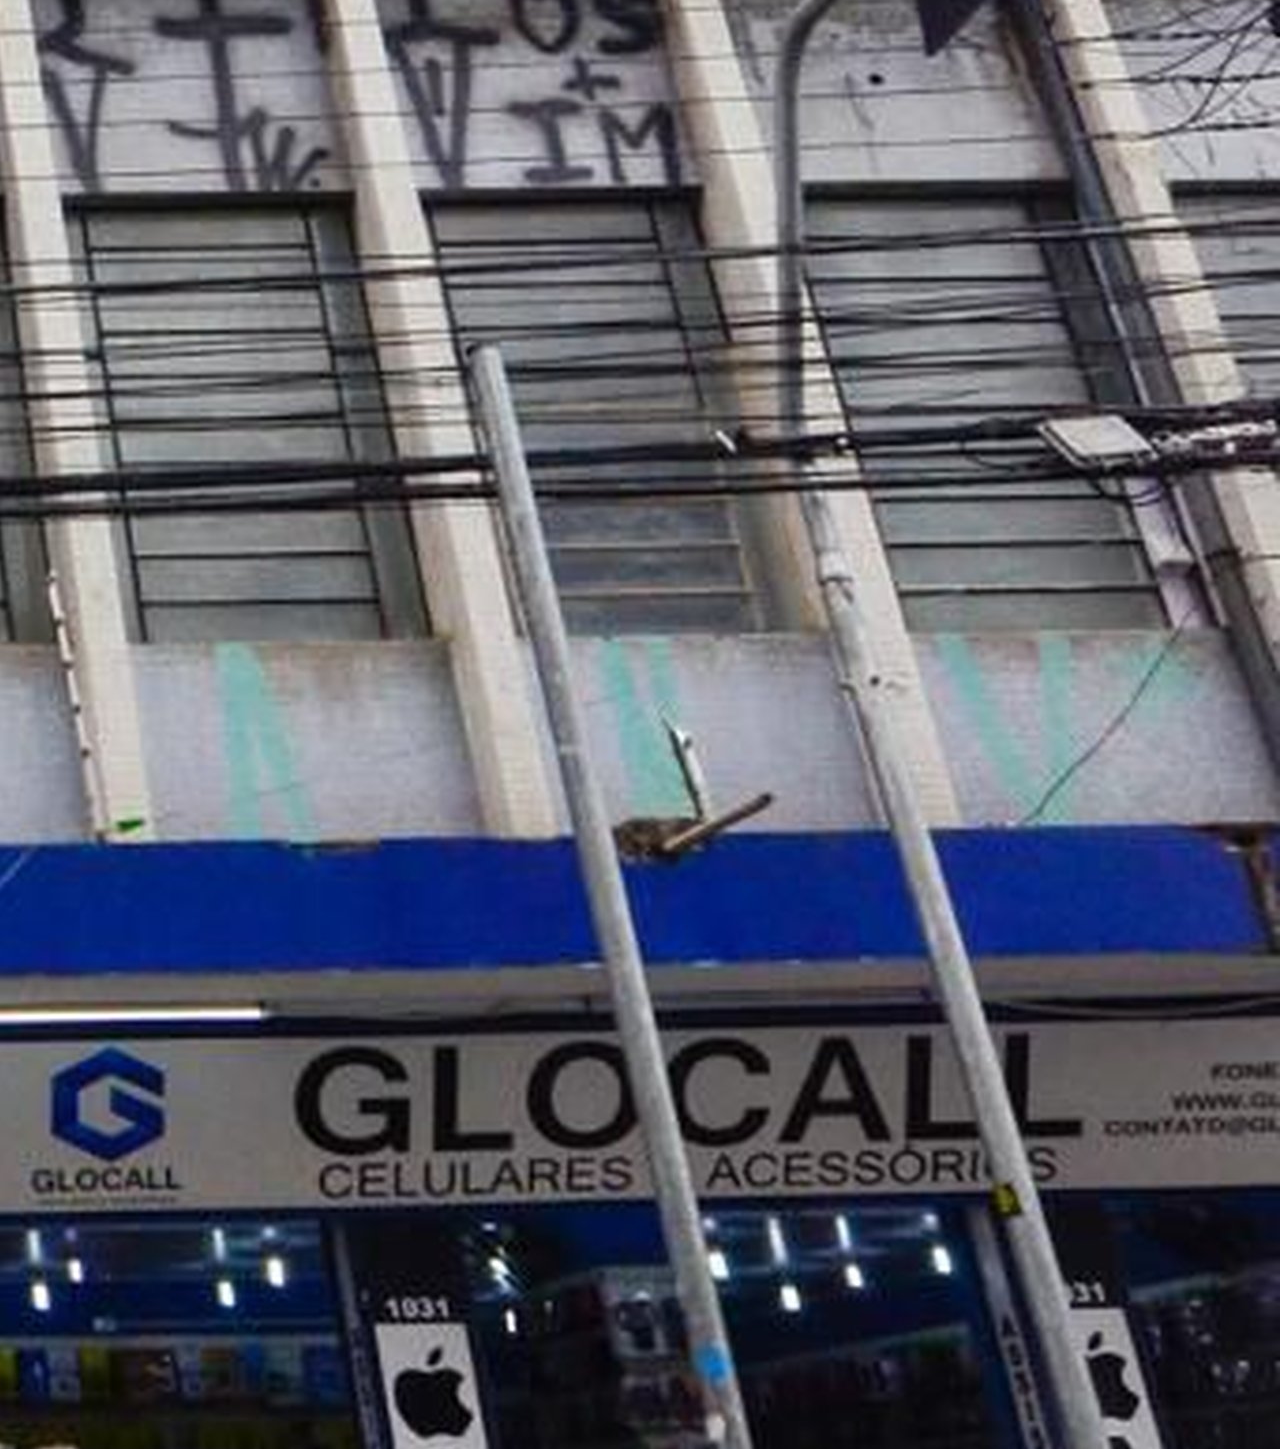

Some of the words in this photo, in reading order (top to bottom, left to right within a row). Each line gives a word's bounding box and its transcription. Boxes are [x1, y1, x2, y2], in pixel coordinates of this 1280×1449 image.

[292, 1032, 1083, 1157] GLOCALL
[29, 1165, 184, 1196] GLOCALL
[317, 1155, 635, 1201] CELULARES
[705, 1143, 1059, 1190] ACESSÓRIS
[385, 1296, 451, 1319] 1031
